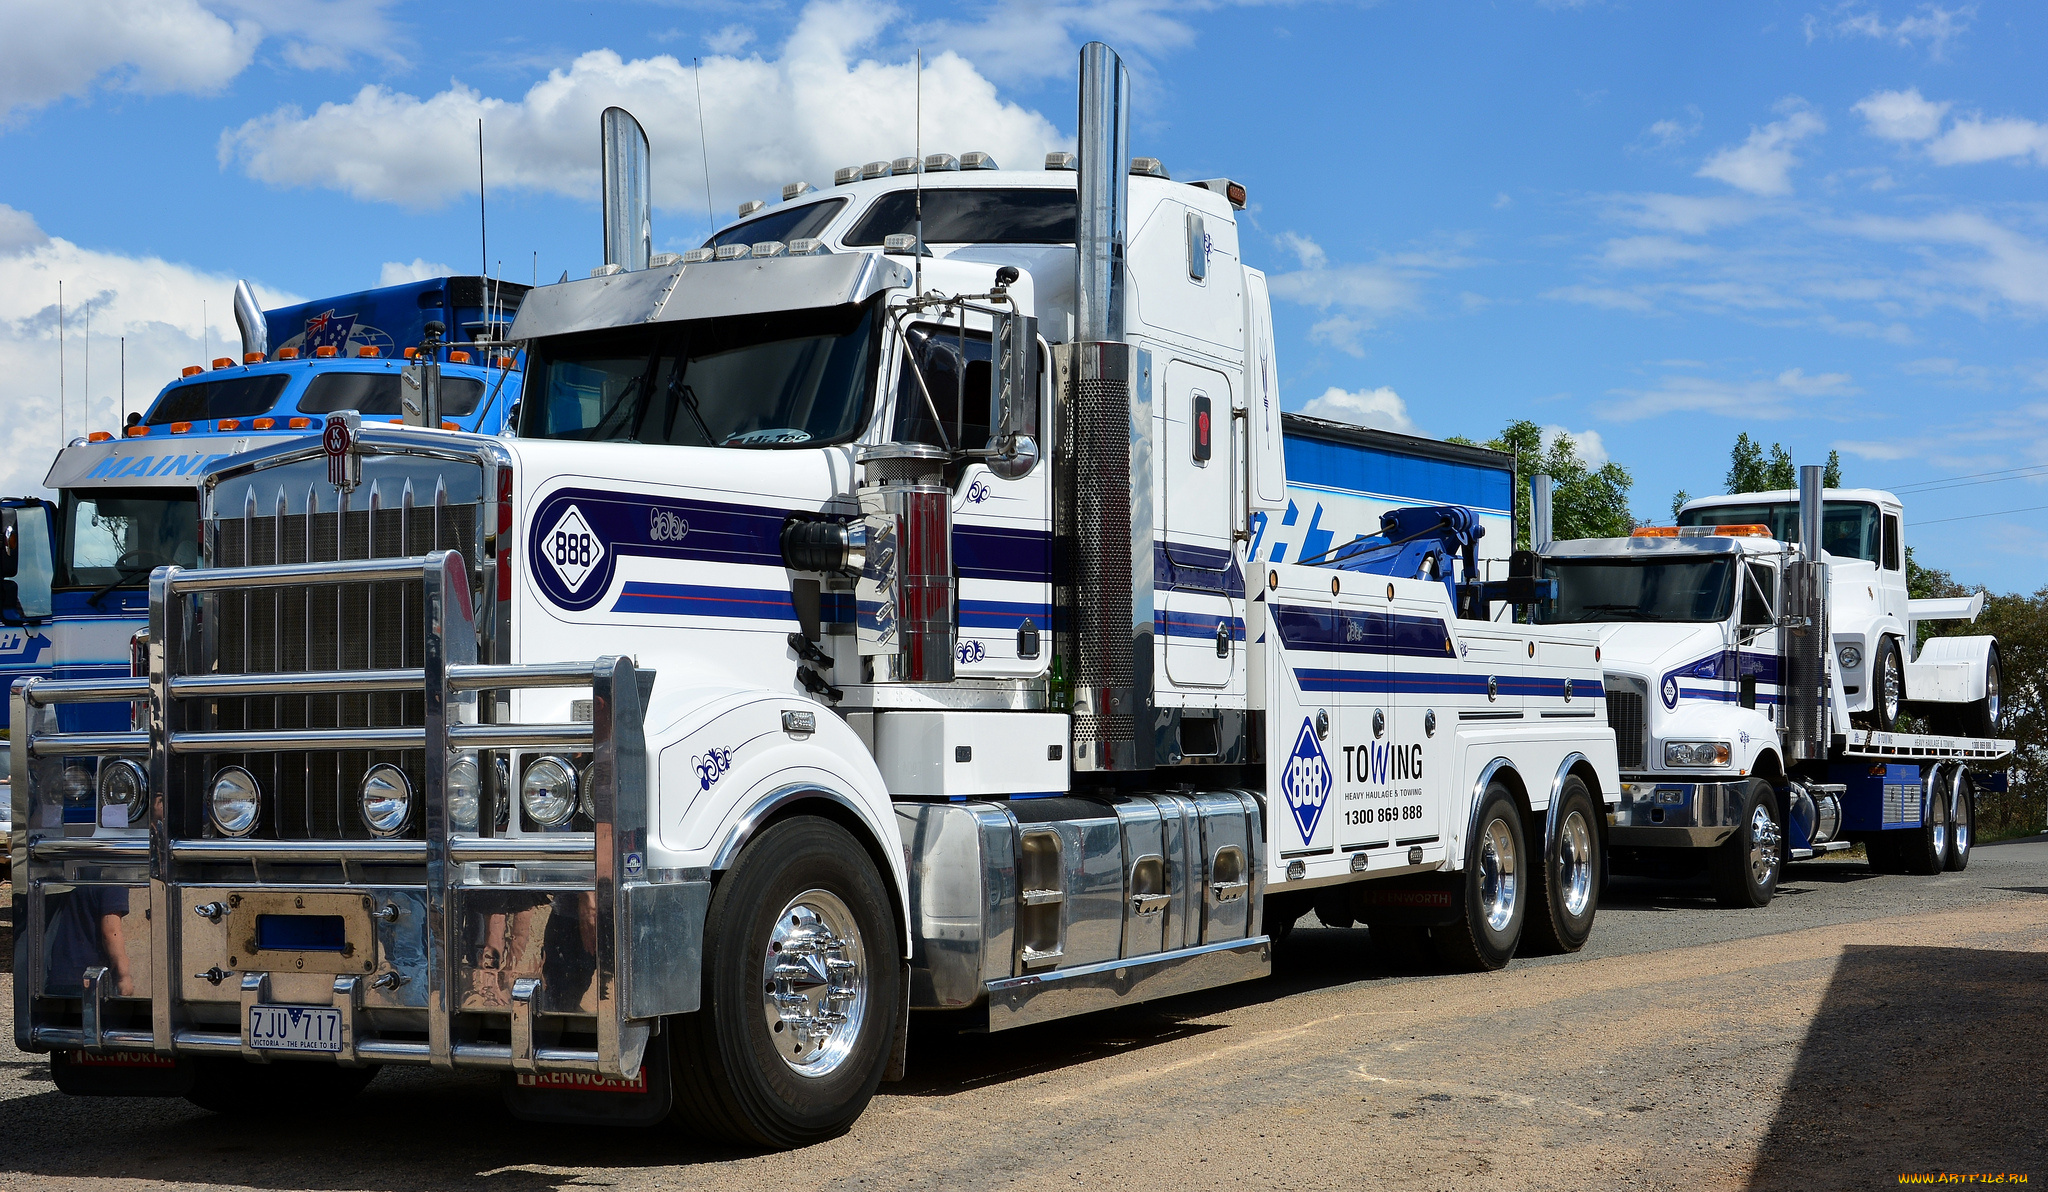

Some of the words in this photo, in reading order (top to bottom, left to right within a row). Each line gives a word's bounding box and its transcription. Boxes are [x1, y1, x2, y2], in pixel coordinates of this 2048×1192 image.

[555, 530, 591, 568] 888
[1343, 741, 1422, 785] TOWING
[1292, 755, 1322, 809] 888
[1344, 792, 1364, 801] HEAVY
[1365, 790, 1393, 799] HAULAGE
[1400, 788, 1422, 797] TOWING
[1344, 809, 1374, 825] 1300
[1377, 807, 1399, 822] 869
[1402, 805, 1423, 820] 888
[253, 1012, 287, 1039] ZJU
[302, 1014, 336, 1041] 717
[300, 1041, 317, 1049] PLACE
